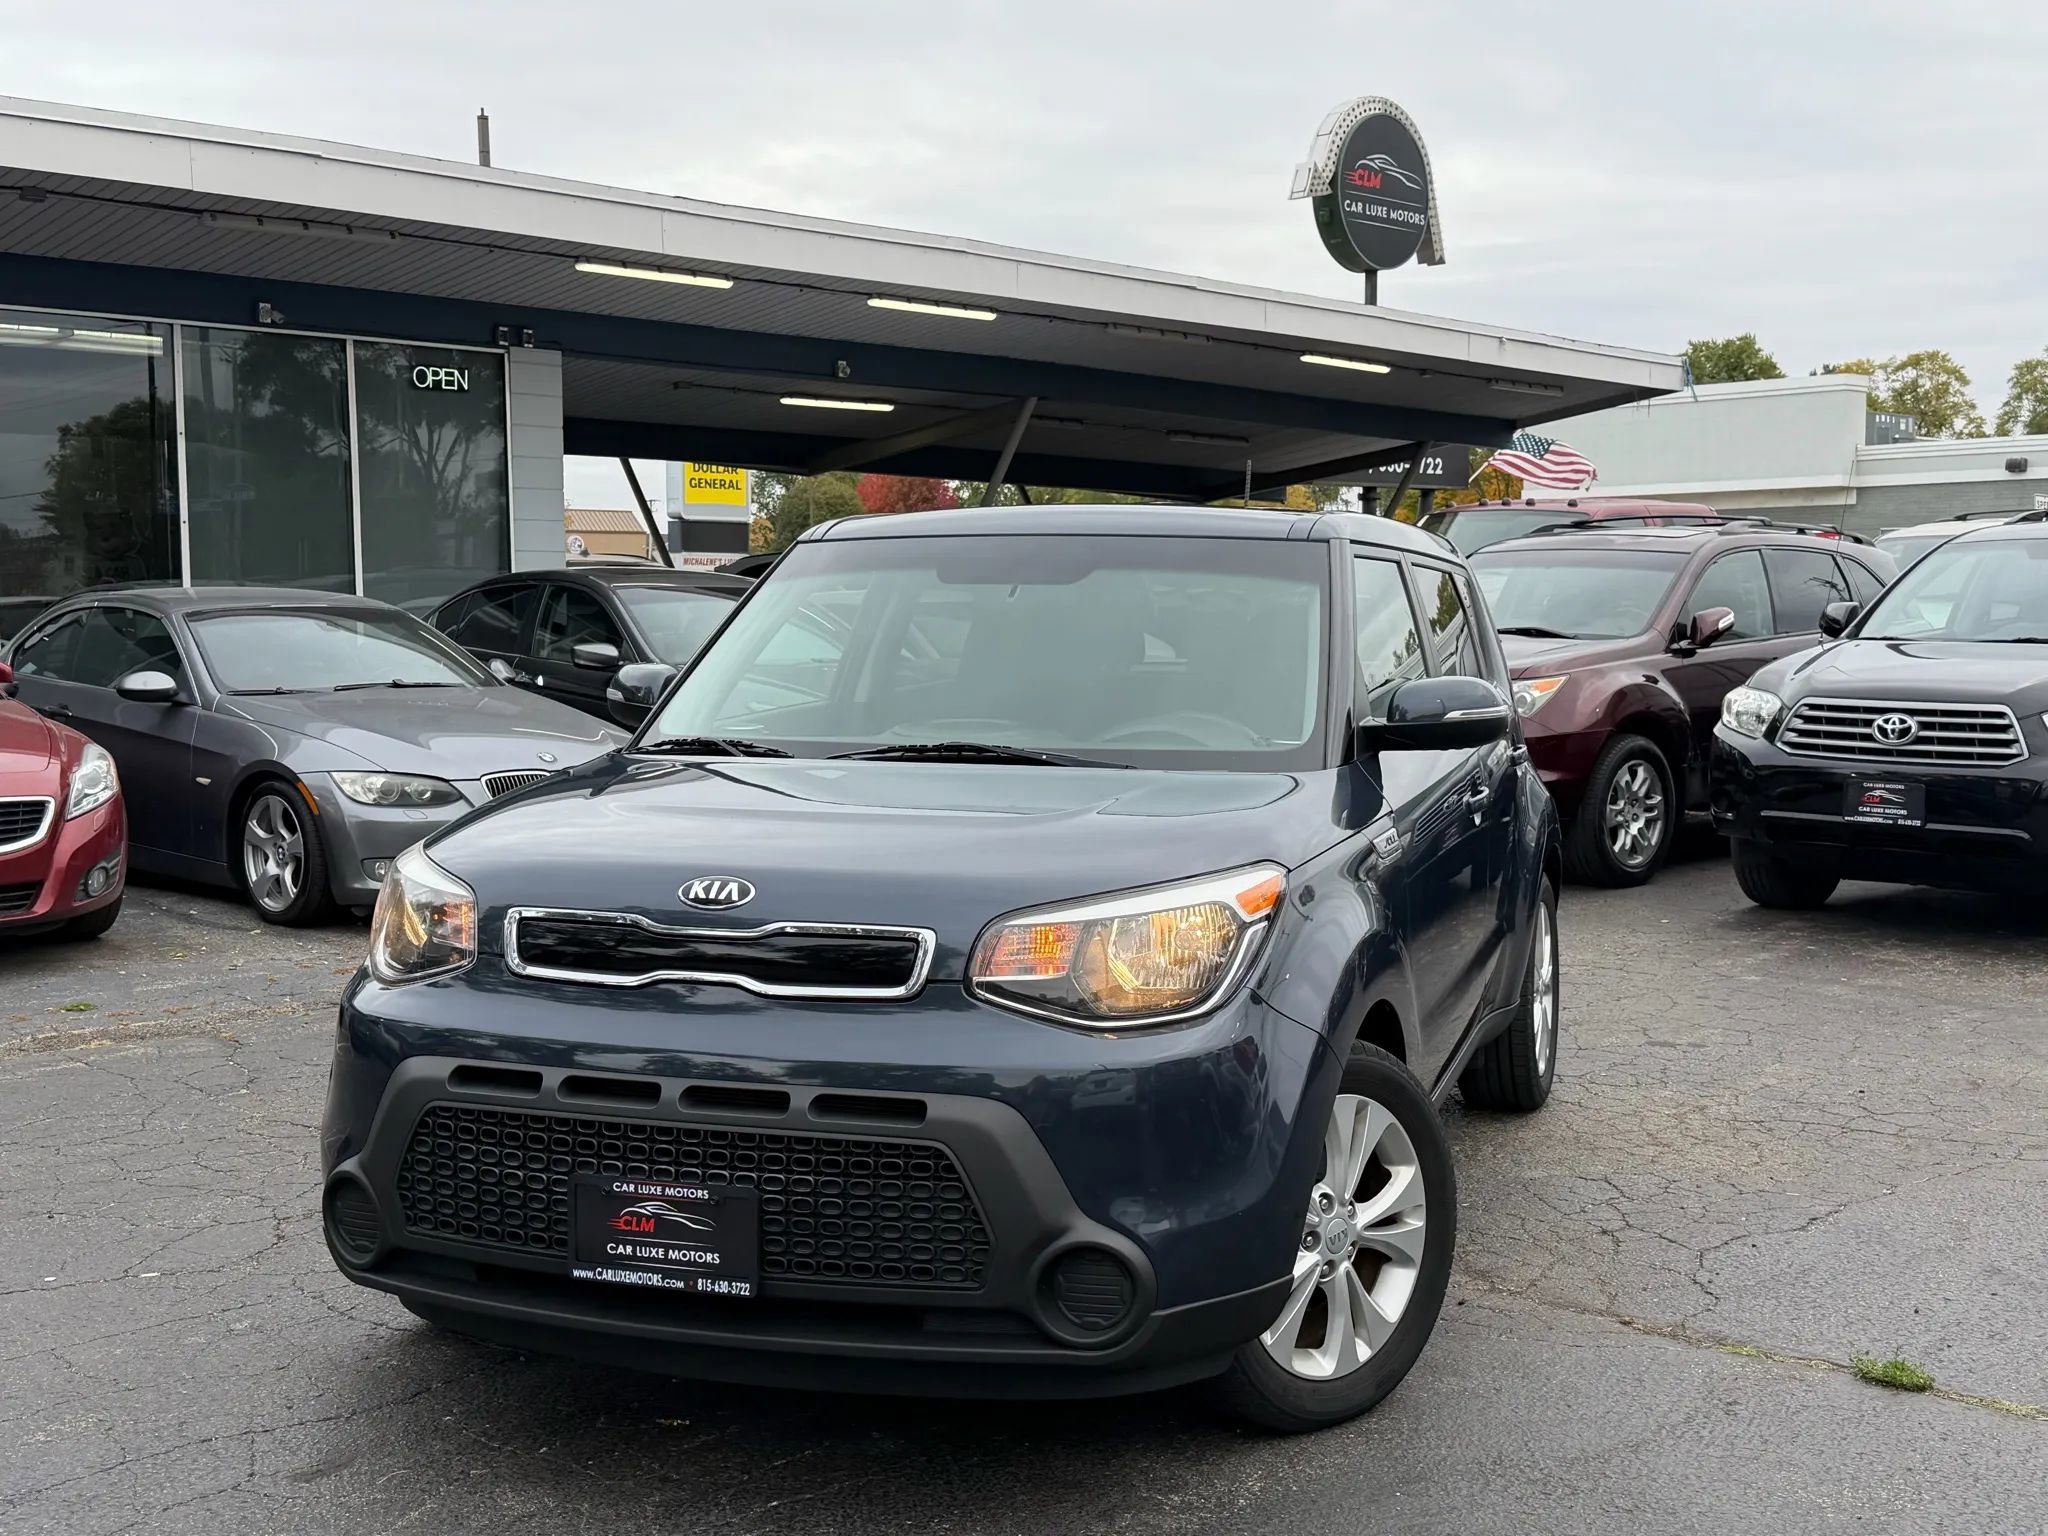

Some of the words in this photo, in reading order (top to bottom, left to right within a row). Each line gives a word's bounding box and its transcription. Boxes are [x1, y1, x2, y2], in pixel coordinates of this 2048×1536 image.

[1355, 169, 1382, 189] CLM
[1344, 200, 1363, 214] CAR
[1366, 203, 1388, 218] LUXE
[1390, 208, 1425, 226] MOTORS
[413, 366, 468, 391] OPEN
[693, 463, 739, 475] DOLLAR
[689, 477, 742, 491] GENERAL
[688, 880, 739, 901] KIA
[613, 1182, 635, 1193] CAR
[638, 1184, 662, 1195] LUXE
[665, 1187, 709, 1199] MOTORS
[620, 1215, 656, 1233] CLM
[606, 1243, 633, 1256] CAR
[636, 1246, 665, 1259] LUXE
[668, 1249, 720, 1264] MOTORS
[697, 1278, 750, 1296] 815-630-3722
